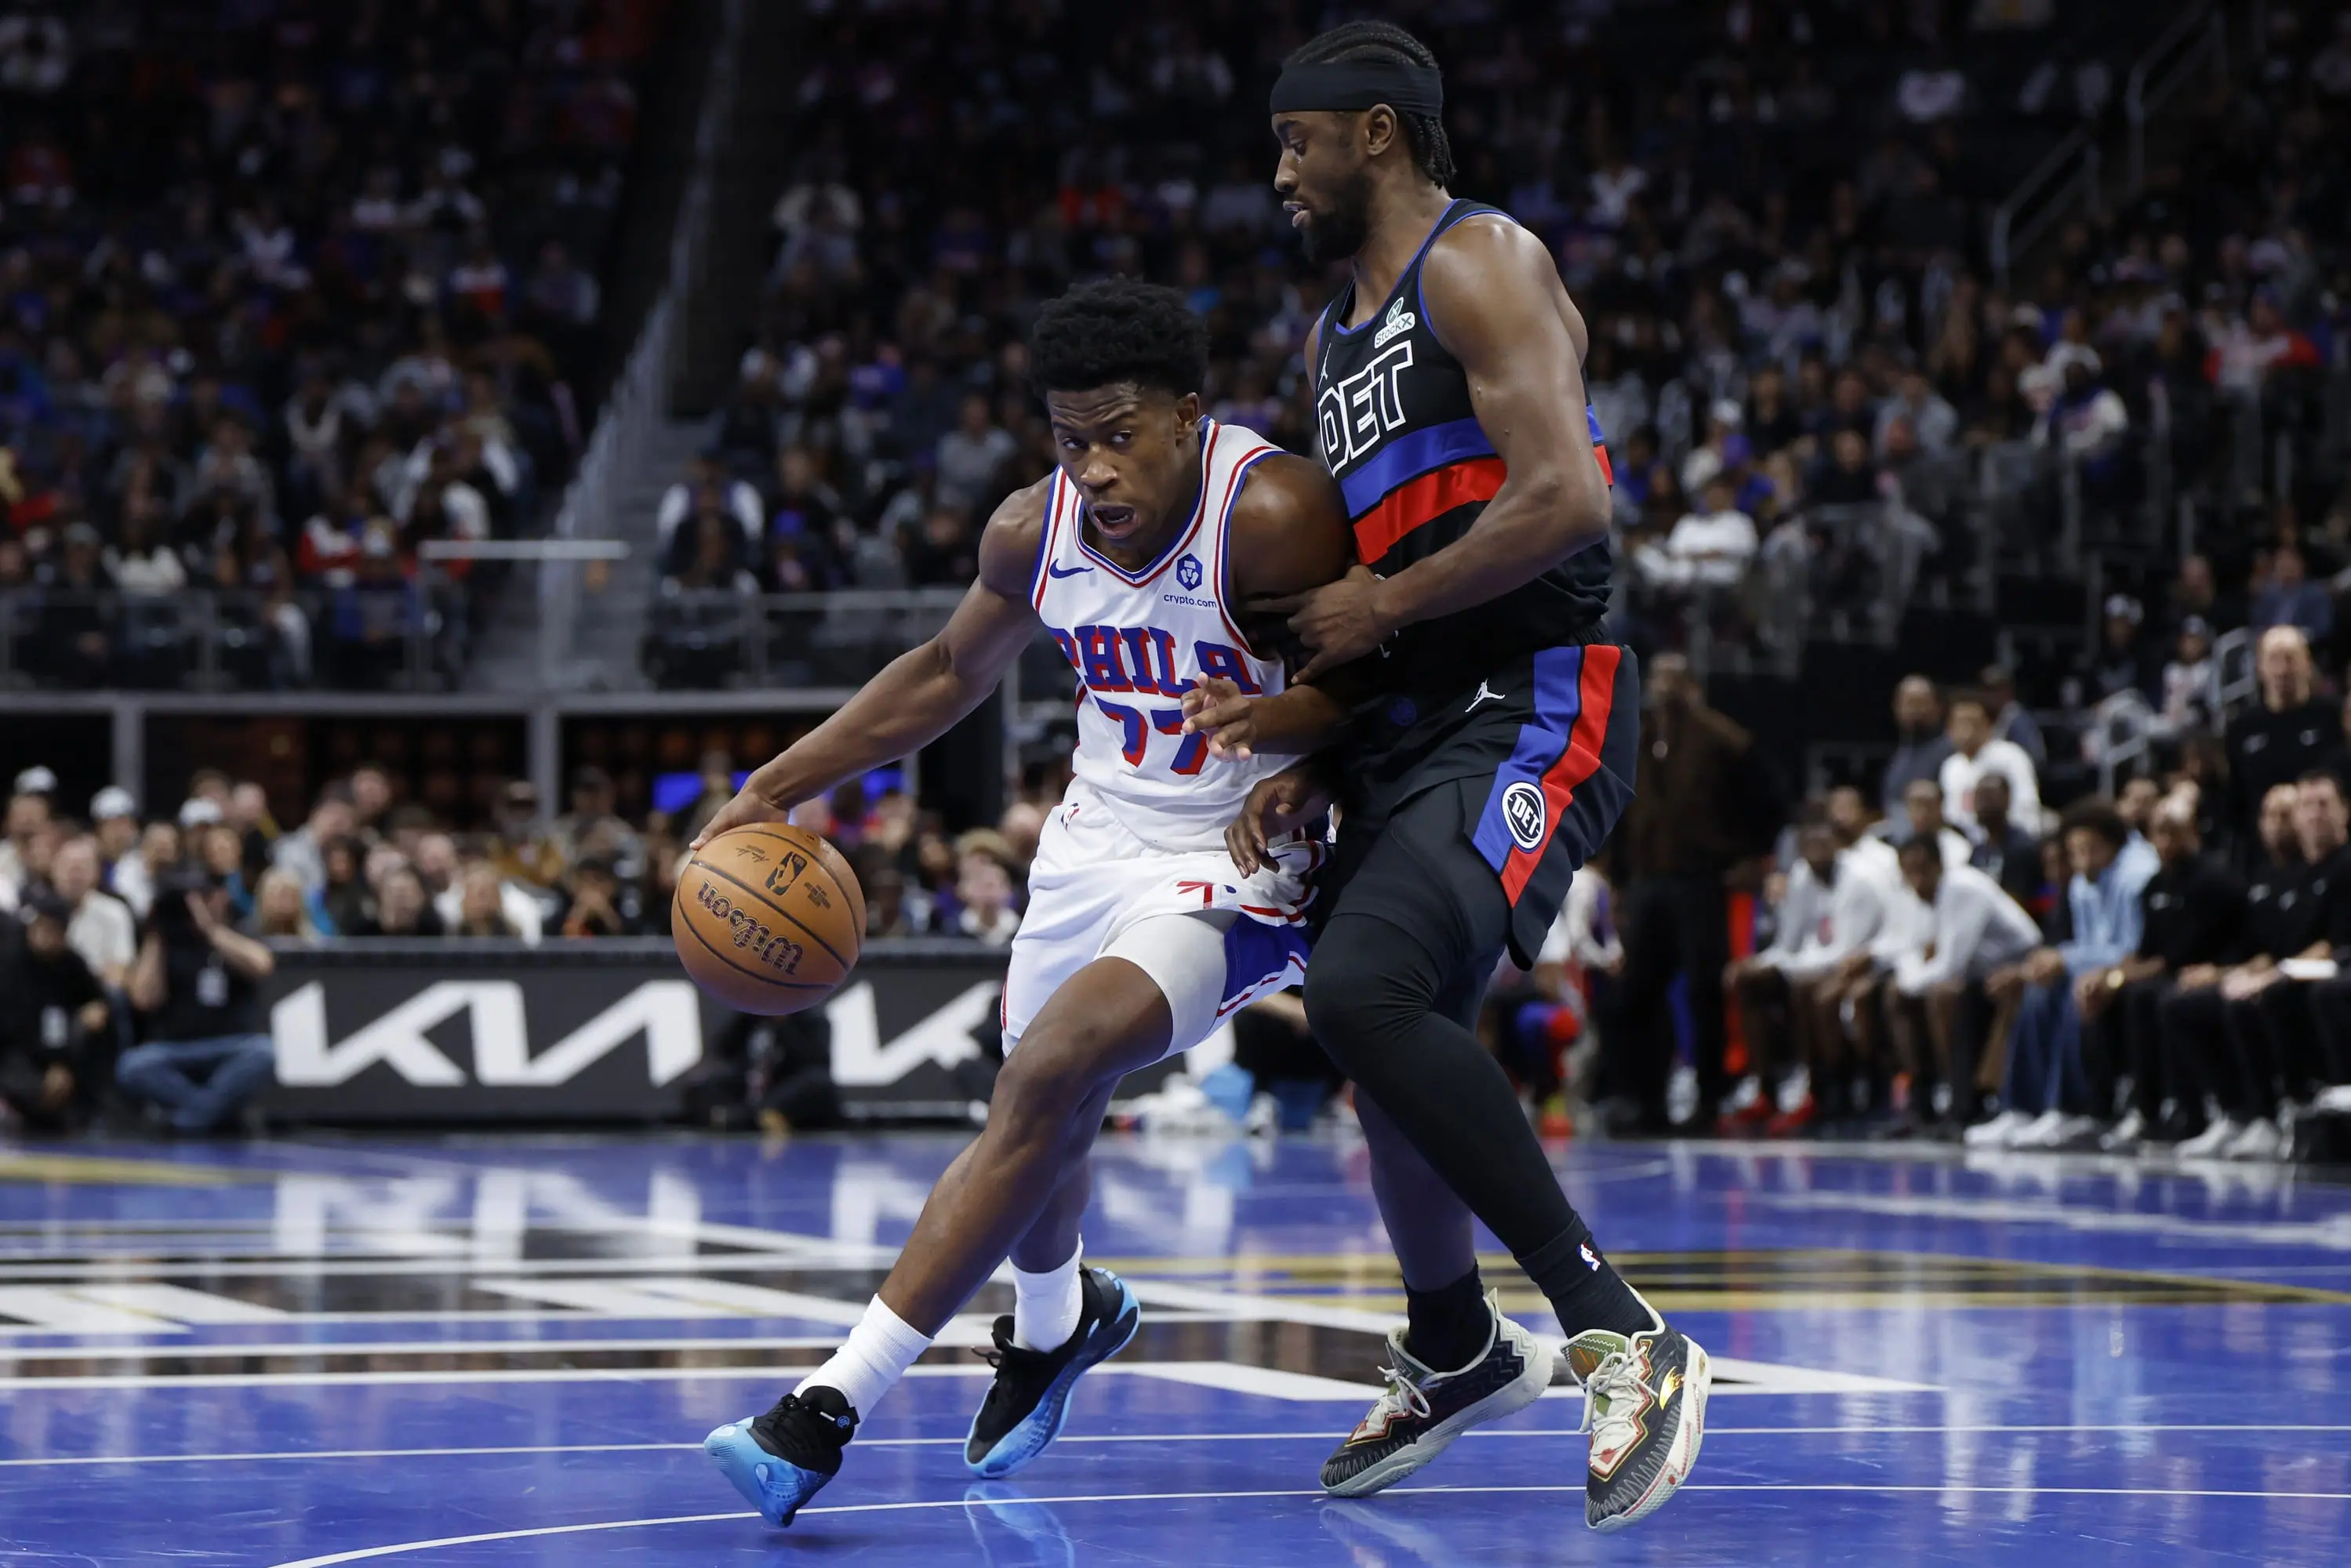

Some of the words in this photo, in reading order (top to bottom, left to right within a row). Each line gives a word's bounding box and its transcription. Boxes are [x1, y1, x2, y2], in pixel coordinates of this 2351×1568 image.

[1376, 314, 1412, 345] StockX
[1317, 339, 1414, 478] DET
[1164, 593, 1217, 609] crypto.com
[1093, 695, 1209, 775] 77
[1512, 793, 1540, 836] DET
